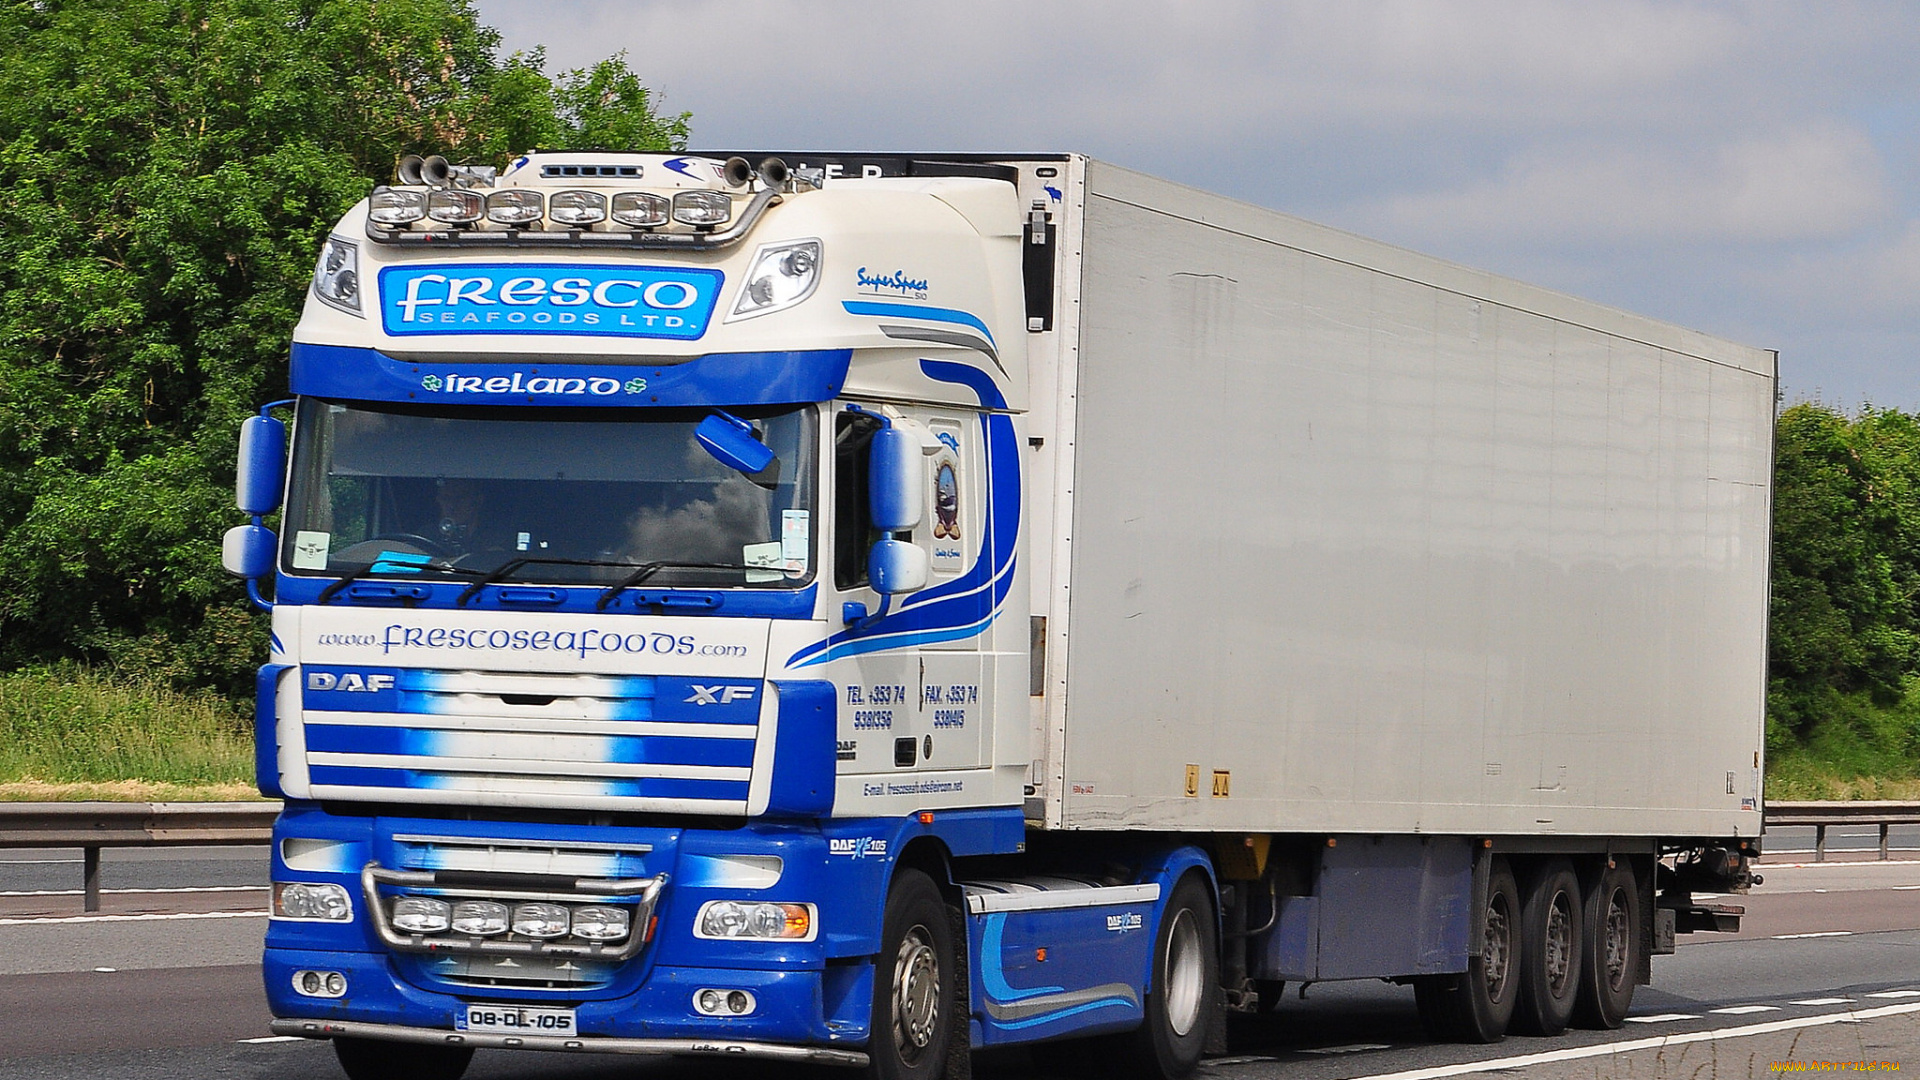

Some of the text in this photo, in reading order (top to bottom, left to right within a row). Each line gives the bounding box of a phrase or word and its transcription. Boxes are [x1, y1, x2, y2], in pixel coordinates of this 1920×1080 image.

[418, 312, 697, 329] SEAFOODS LTD.
[318, 624, 748, 660] www.frescoseafoods.com
[307, 673, 395, 692] DAF
[683, 685, 756, 705] XF
[869, 686, 892, 704] +353
[894, 686, 906, 704] 74
[968, 686, 978, 704] 74
[830, 839, 856, 851] DAF
[870, 840, 887, 851] 105
[470, 1011, 572, 1029] 08-DL-105
